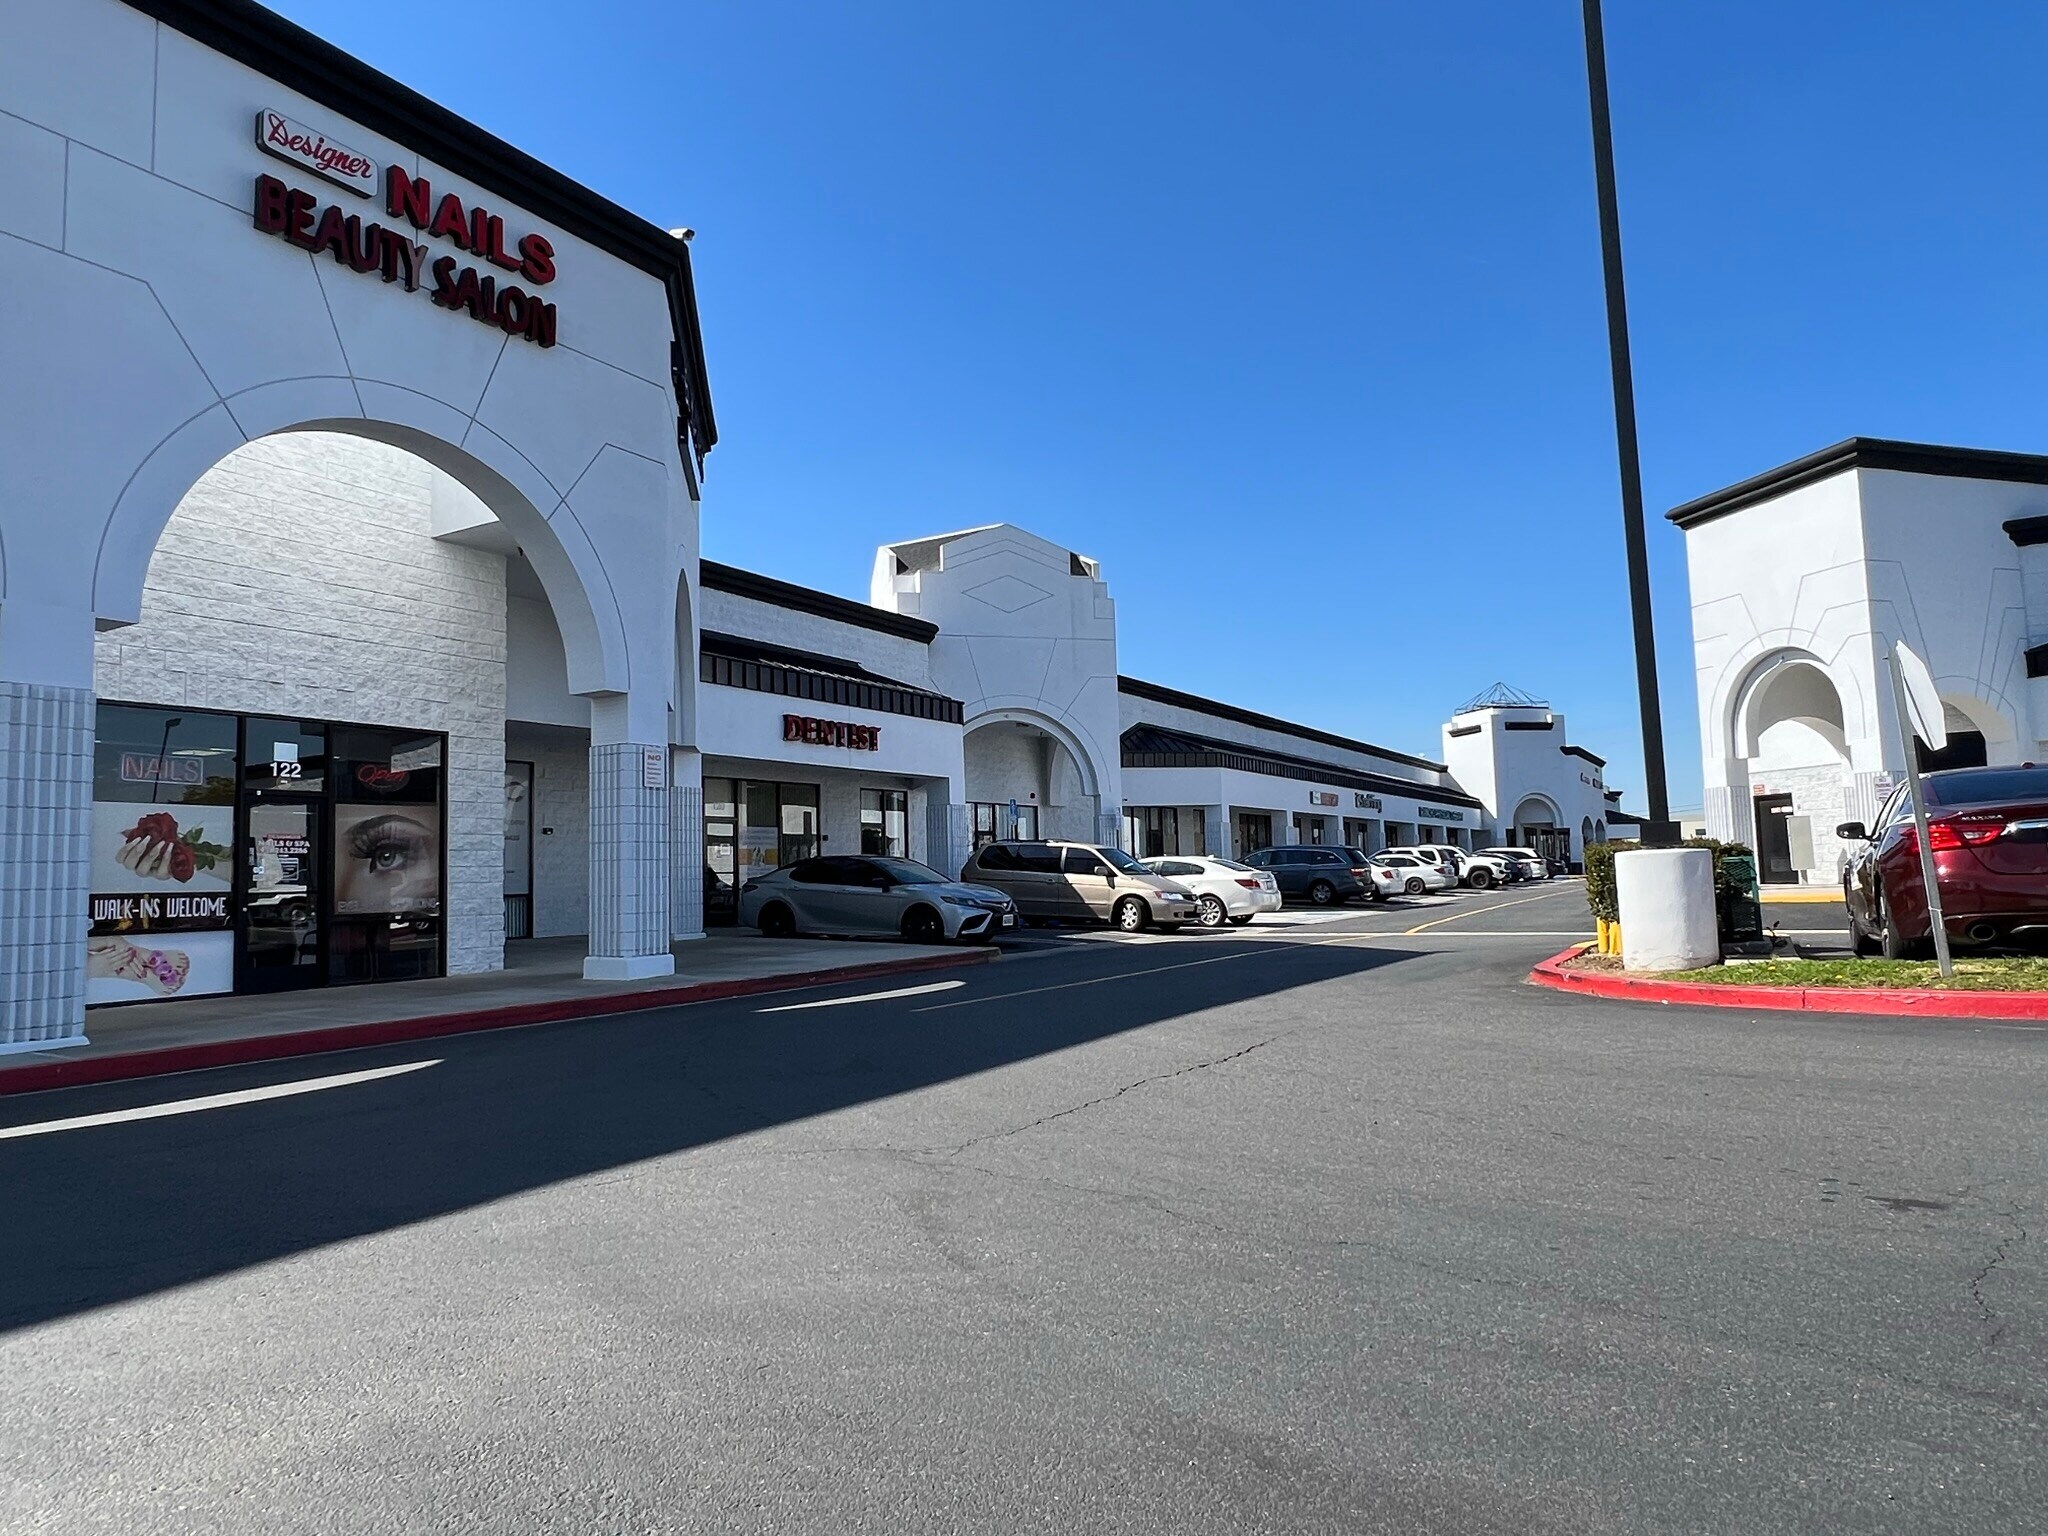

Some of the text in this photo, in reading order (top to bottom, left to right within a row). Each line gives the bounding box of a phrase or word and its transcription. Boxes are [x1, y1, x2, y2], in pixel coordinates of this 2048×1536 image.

[267, 113, 556, 285] Designer NAILS
[253, 173, 557, 348] BEAUTY SALON
[782, 713, 882, 751] DENTIST
[124, 756, 199, 782] NAILS
[270, 761, 302, 778] 122
[94, 896, 227, 921] WALK-INS WELCOME
